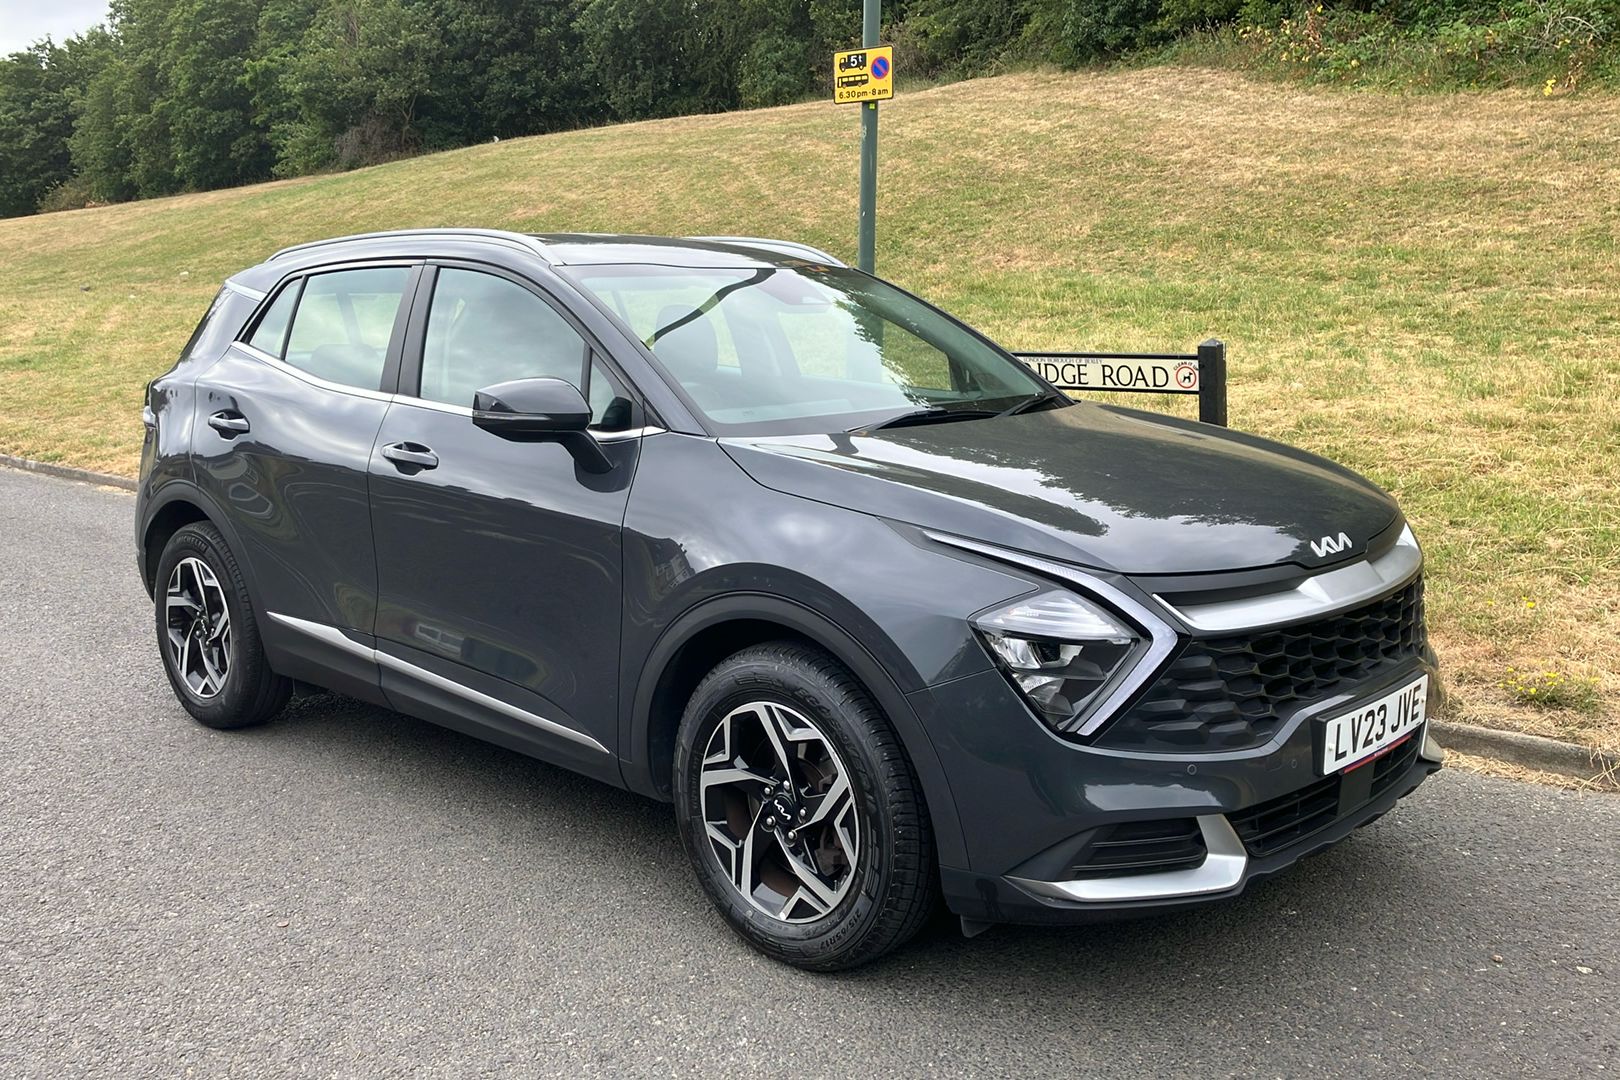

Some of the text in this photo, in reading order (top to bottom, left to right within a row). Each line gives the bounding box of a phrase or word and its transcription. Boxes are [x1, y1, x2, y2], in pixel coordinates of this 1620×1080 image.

[1025, 363, 1169, 388] IDGE ROAD
[1310, 531, 1352, 557] KIA
[1334, 683, 1421, 762] LV23 JVE
